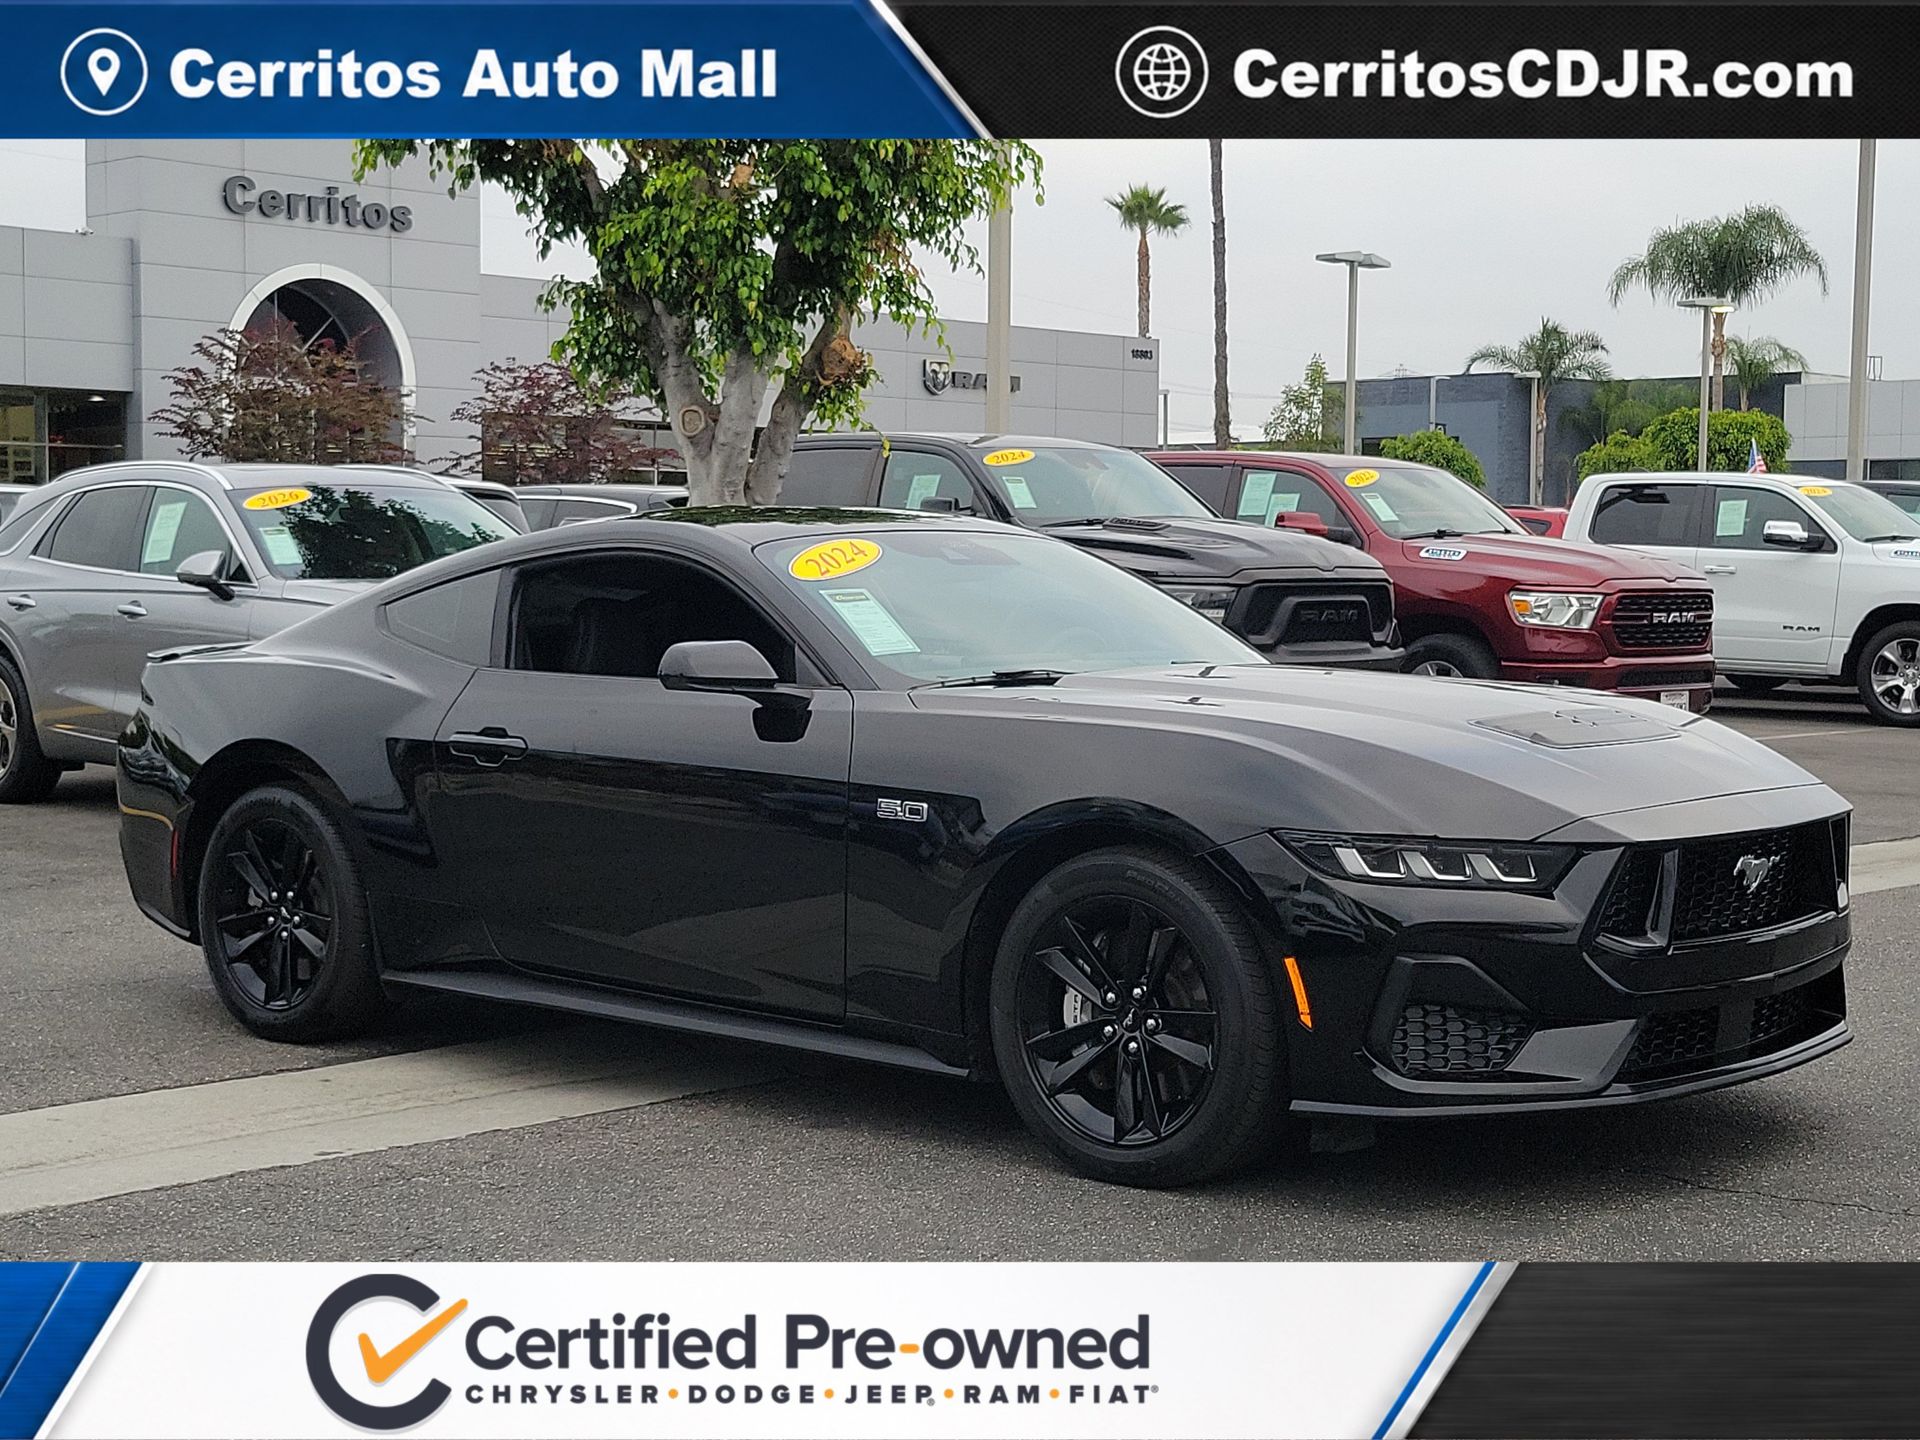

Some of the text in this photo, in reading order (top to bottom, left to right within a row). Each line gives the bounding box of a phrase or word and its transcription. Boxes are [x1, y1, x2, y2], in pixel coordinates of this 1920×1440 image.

[222, 174, 414, 233] Cerritos
[256, 490, 299, 508] 2026
[805, 541, 868, 577] 2024
[1300, 609, 1359, 622] RAM
[1652, 611, 1696, 624] RAM
[1782, 624, 1821, 632] RAM
